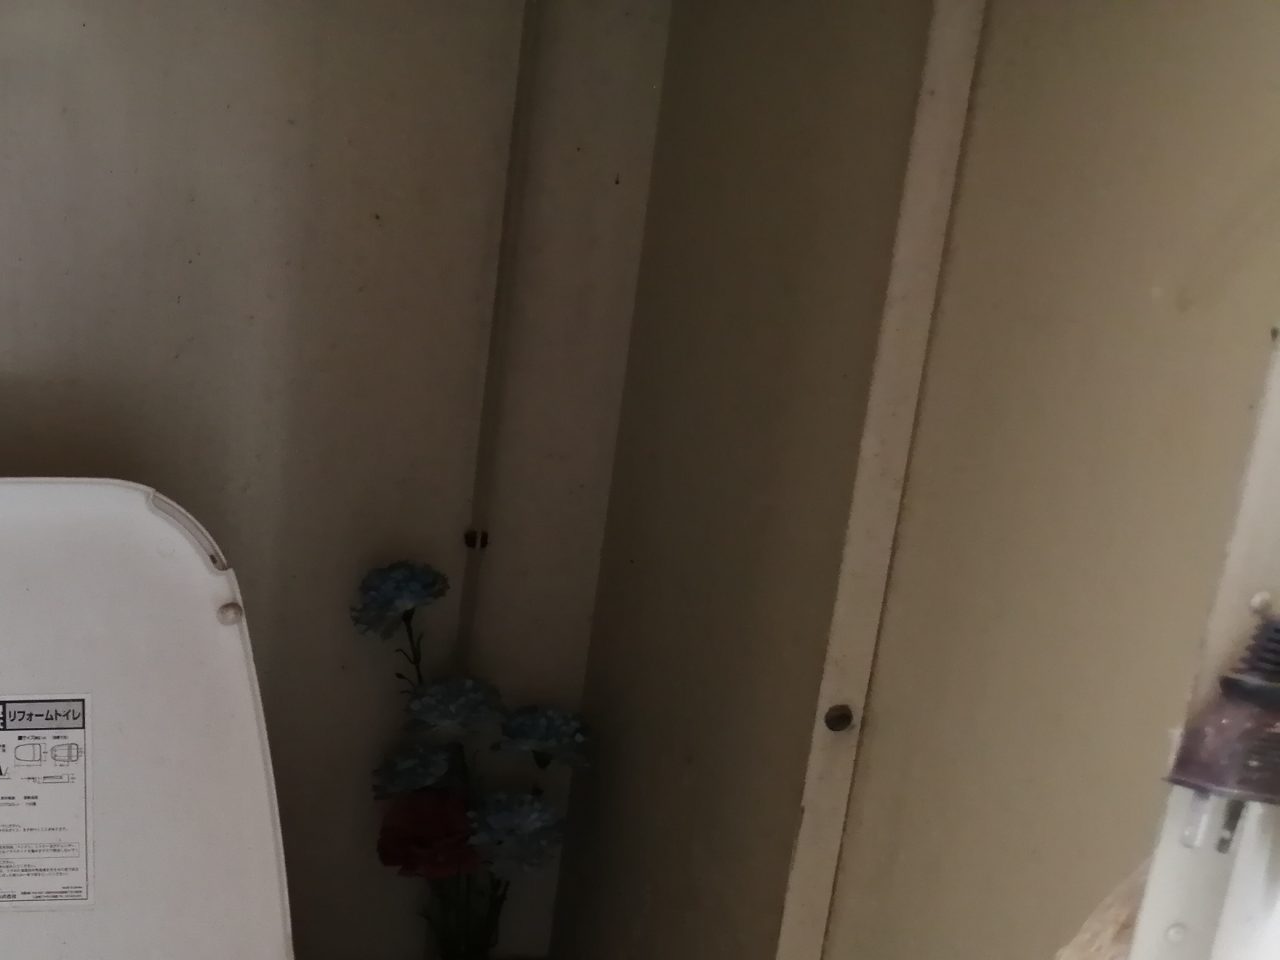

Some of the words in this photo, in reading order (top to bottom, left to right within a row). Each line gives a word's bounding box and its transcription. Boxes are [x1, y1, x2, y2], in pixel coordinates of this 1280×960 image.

[8, 708, 81, 722] リフォームトイレ
